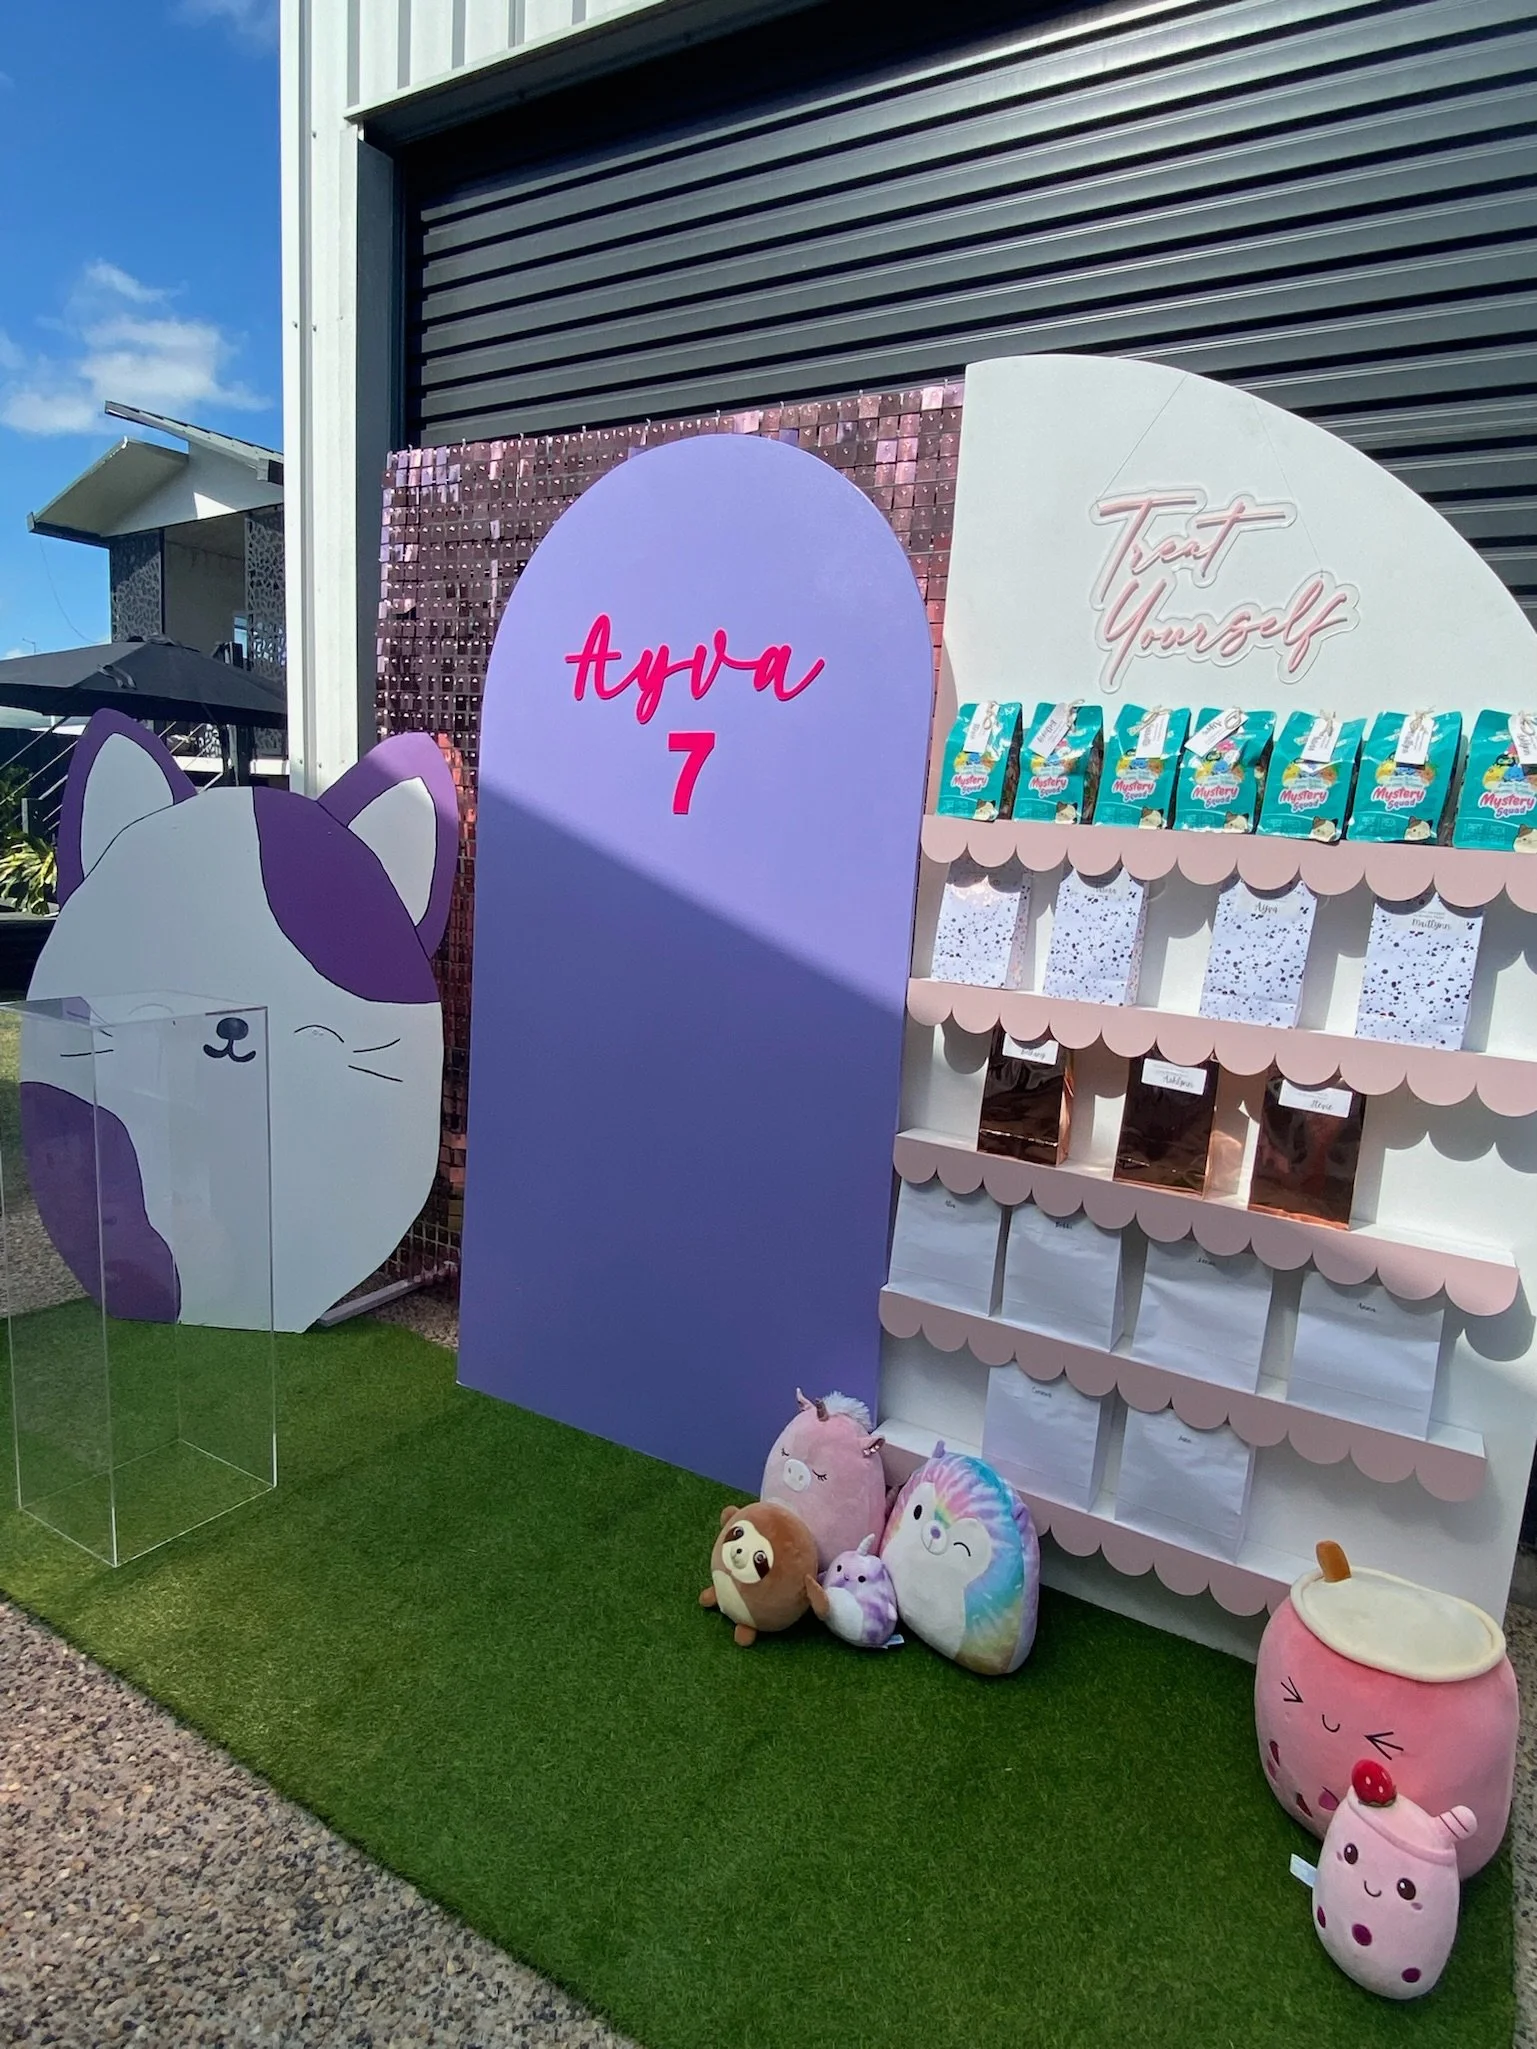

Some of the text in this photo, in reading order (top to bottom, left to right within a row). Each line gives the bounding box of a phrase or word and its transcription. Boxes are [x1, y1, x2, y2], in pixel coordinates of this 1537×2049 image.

[1097, 496, 1287, 604] Treat
[1103, 578, 1349, 686] Yourself
[564, 612, 826, 725] Ayva
[667, 731, 716, 816] 7
[953, 775, 988, 786] Mystery
[1031, 776, 1068, 788] Mystery
[1113, 780, 1155, 795] Mystery
[1193, 785, 1238, 800] Mystery
[1280, 789, 1328, 804] Mystery
[1373, 787, 1425, 802] Mystery
[1293, 801, 1320, 811] Squad
[1387, 799, 1416, 810] Squad
[1481, 793, 1535, 809] Mystery
[1496, 805, 1526, 817] Squad
